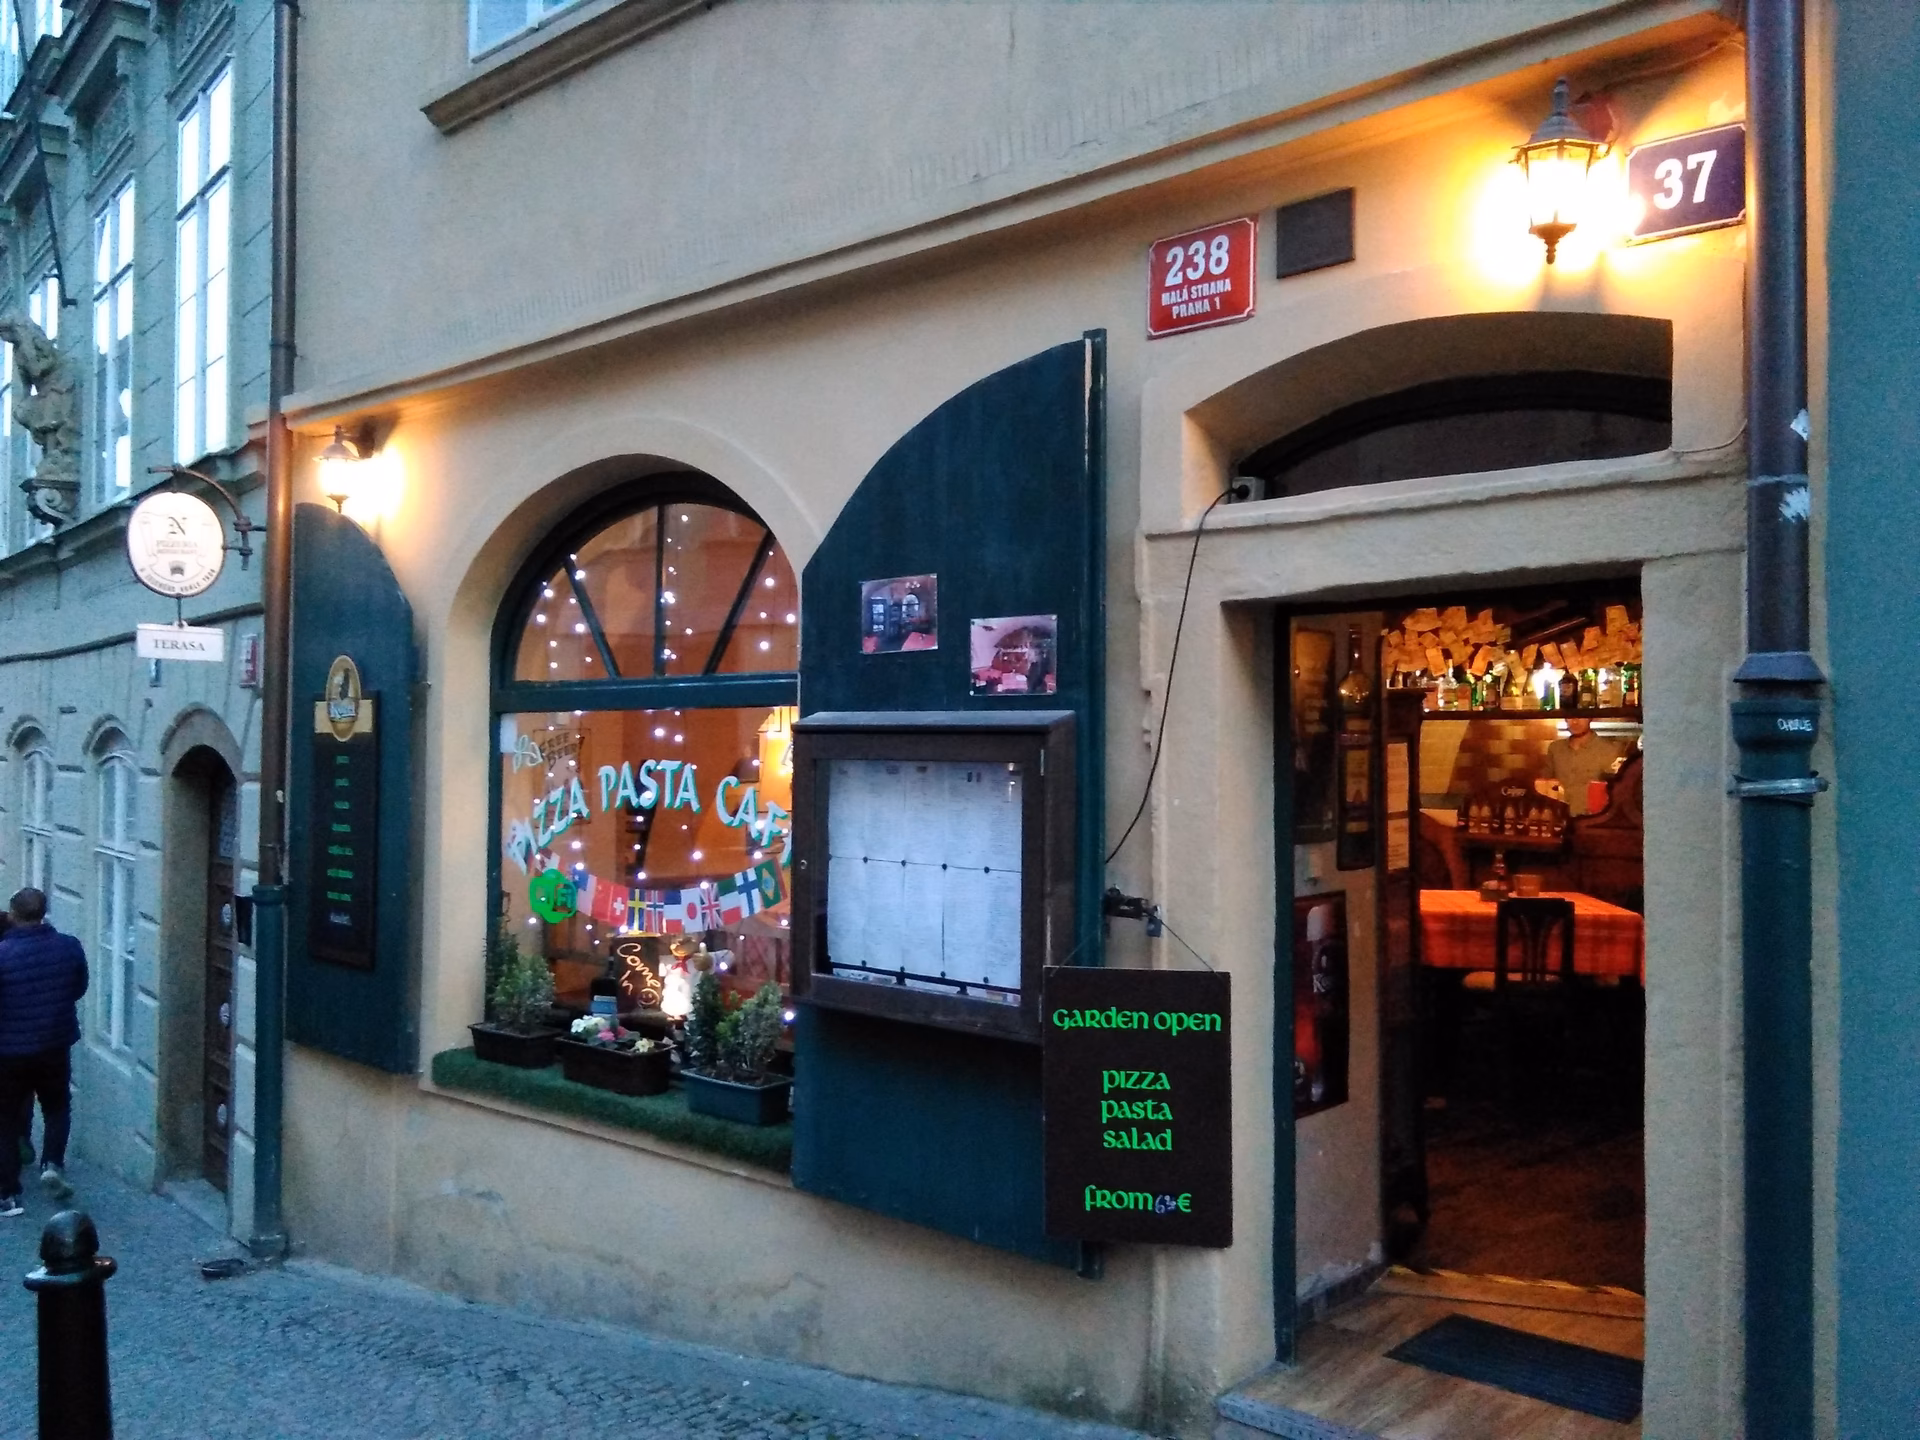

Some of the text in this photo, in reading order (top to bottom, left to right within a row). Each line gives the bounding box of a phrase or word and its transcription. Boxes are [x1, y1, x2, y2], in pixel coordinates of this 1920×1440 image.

[1653, 150, 1717, 210] 37
[1164, 234, 1230, 287] 238
[1161, 278, 1232, 306] MALÁ STRANA
[1172, 297, 1221, 319] PRAHA 1
[153, 638, 206, 652] TERASA
[597, 759, 702, 813] PASTA
[617, 943, 661, 988] Come
